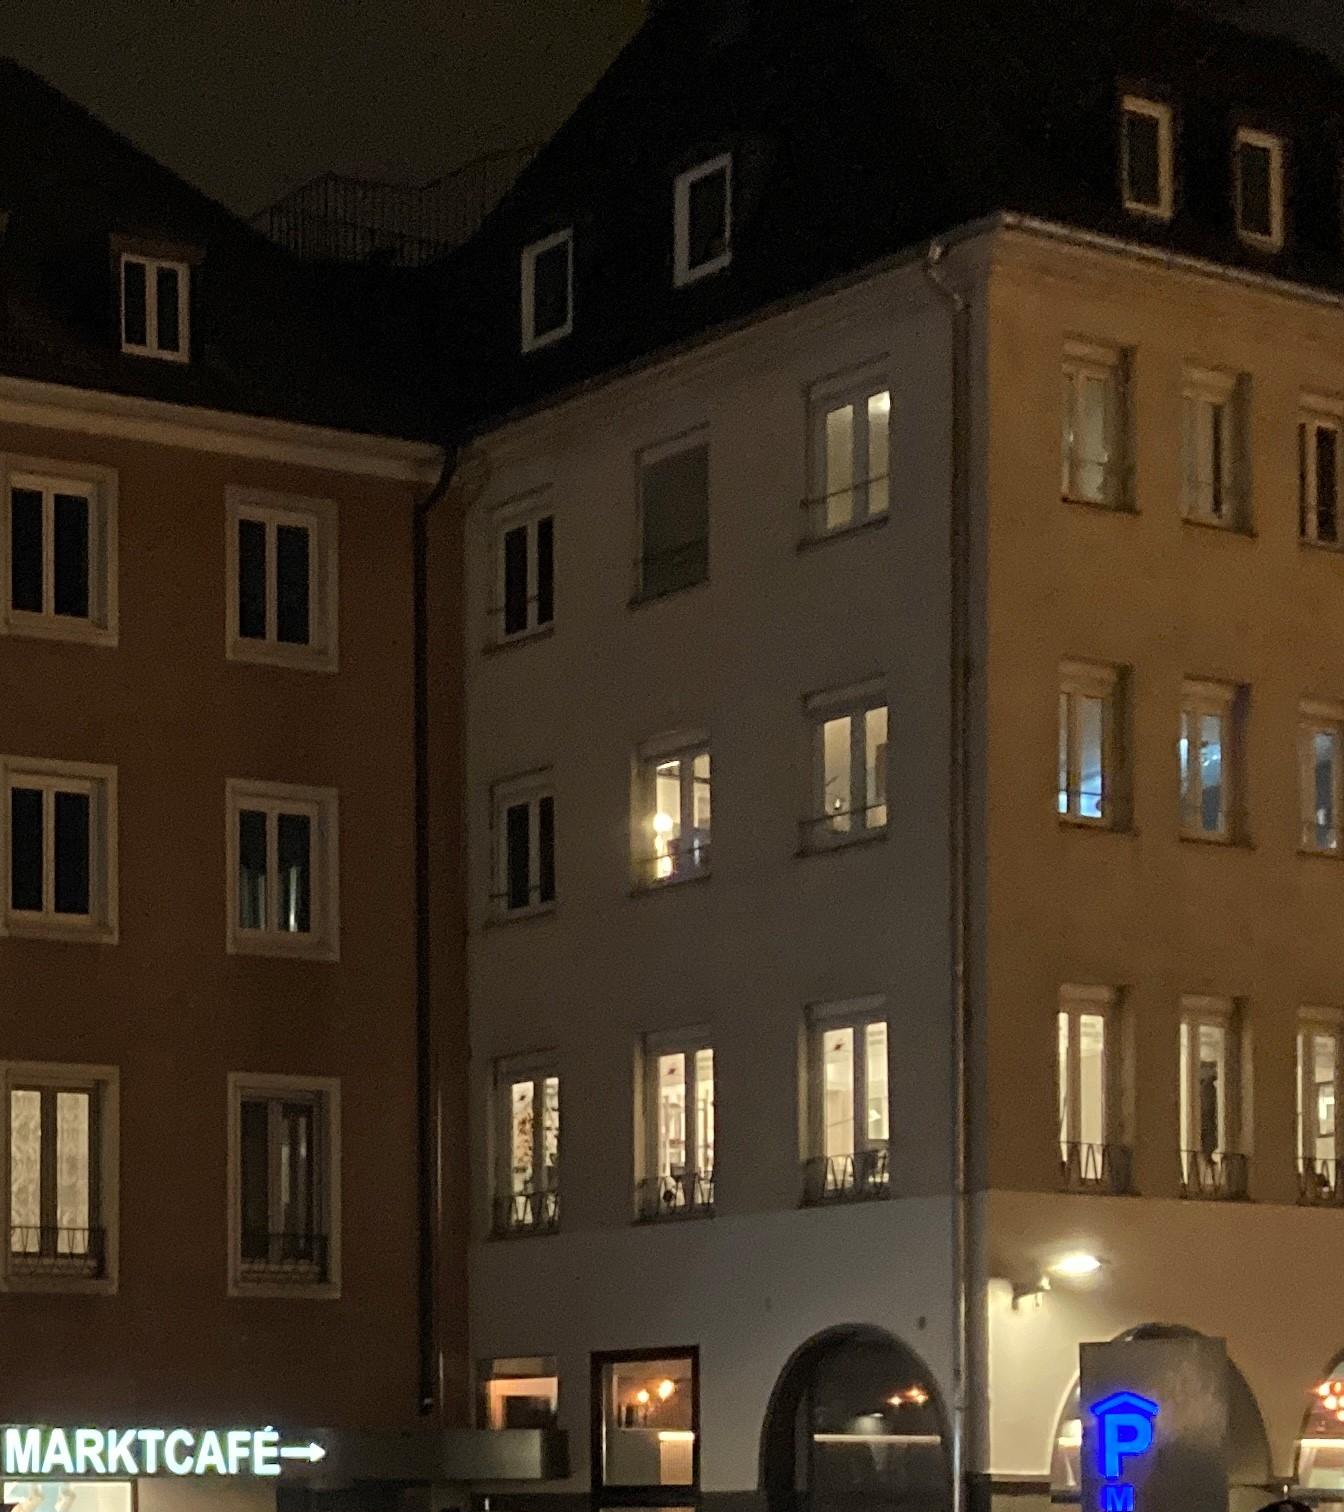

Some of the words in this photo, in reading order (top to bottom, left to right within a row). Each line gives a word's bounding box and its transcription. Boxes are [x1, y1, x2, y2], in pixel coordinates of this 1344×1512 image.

[4, 1425, 282, 1476] MARKTCAFÉ
[1100, 1412, 1153, 1479] P
[1101, 1485, 1135, 1512] M
